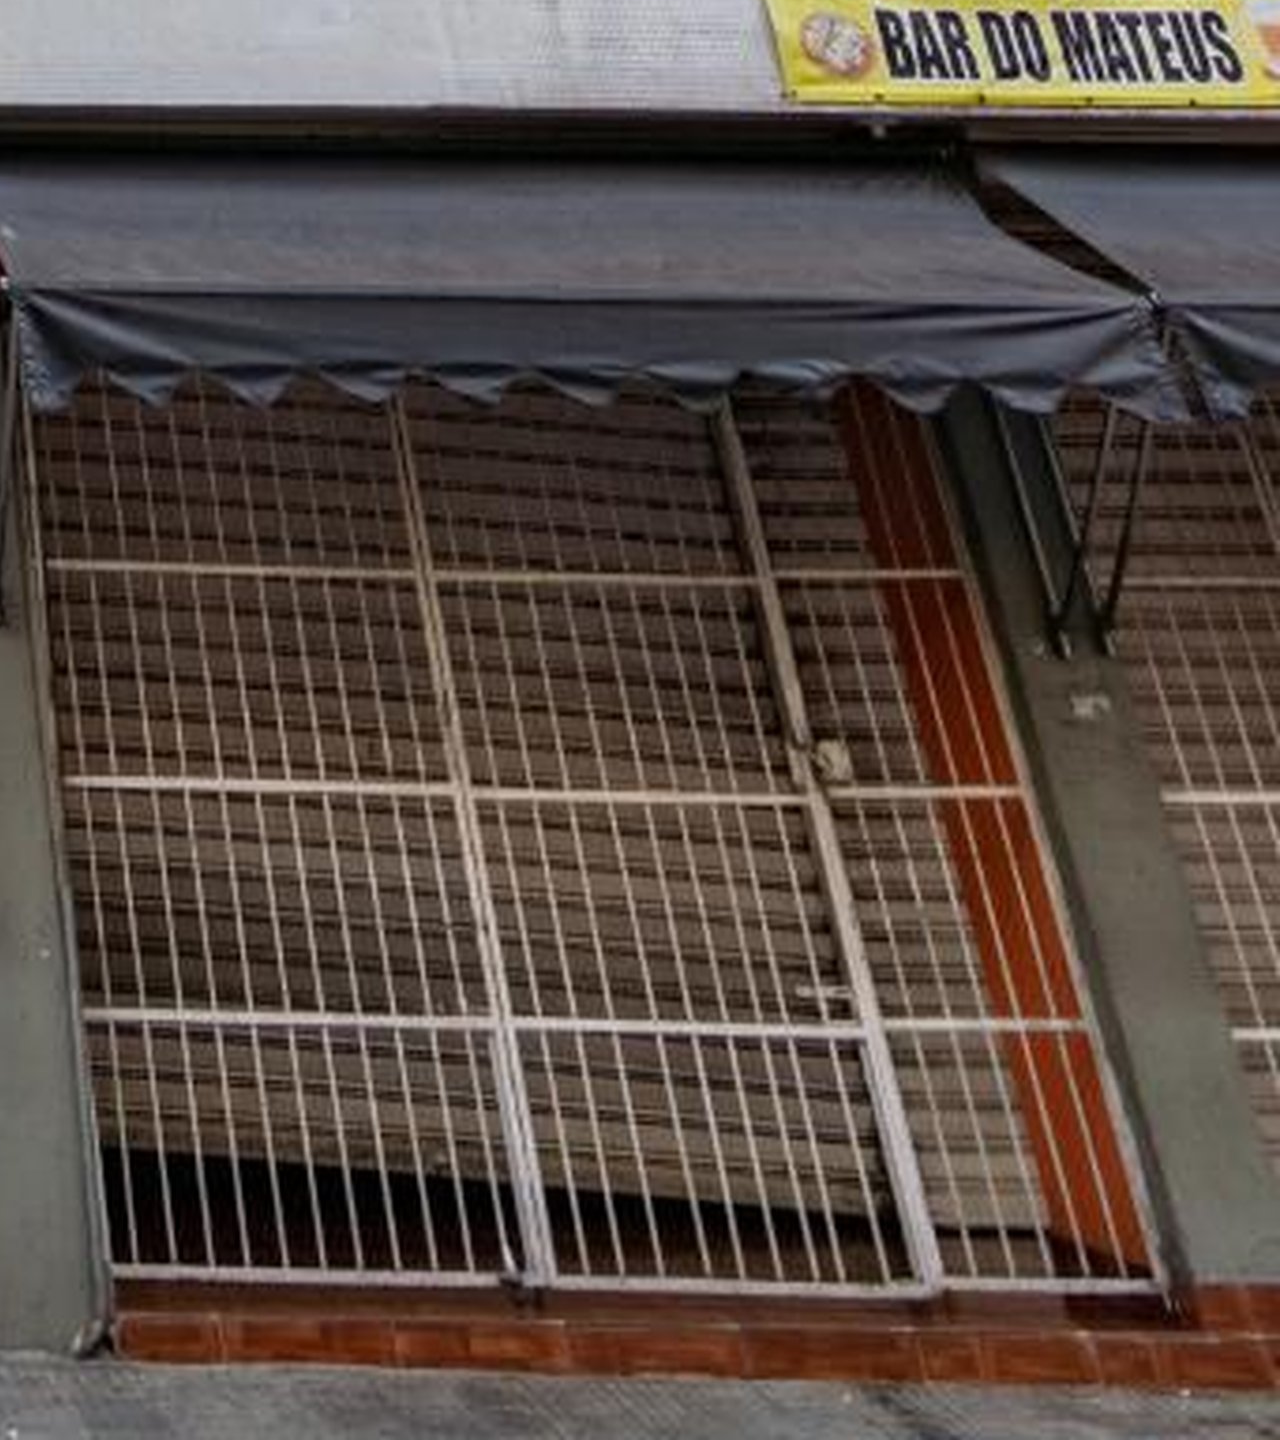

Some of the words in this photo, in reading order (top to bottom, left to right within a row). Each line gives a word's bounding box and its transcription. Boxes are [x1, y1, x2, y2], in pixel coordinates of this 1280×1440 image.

[874, 8, 980, 80] BAR
[976, 10, 1051, 81] DO
[1050, 10, 1243, 83] MATEUS
